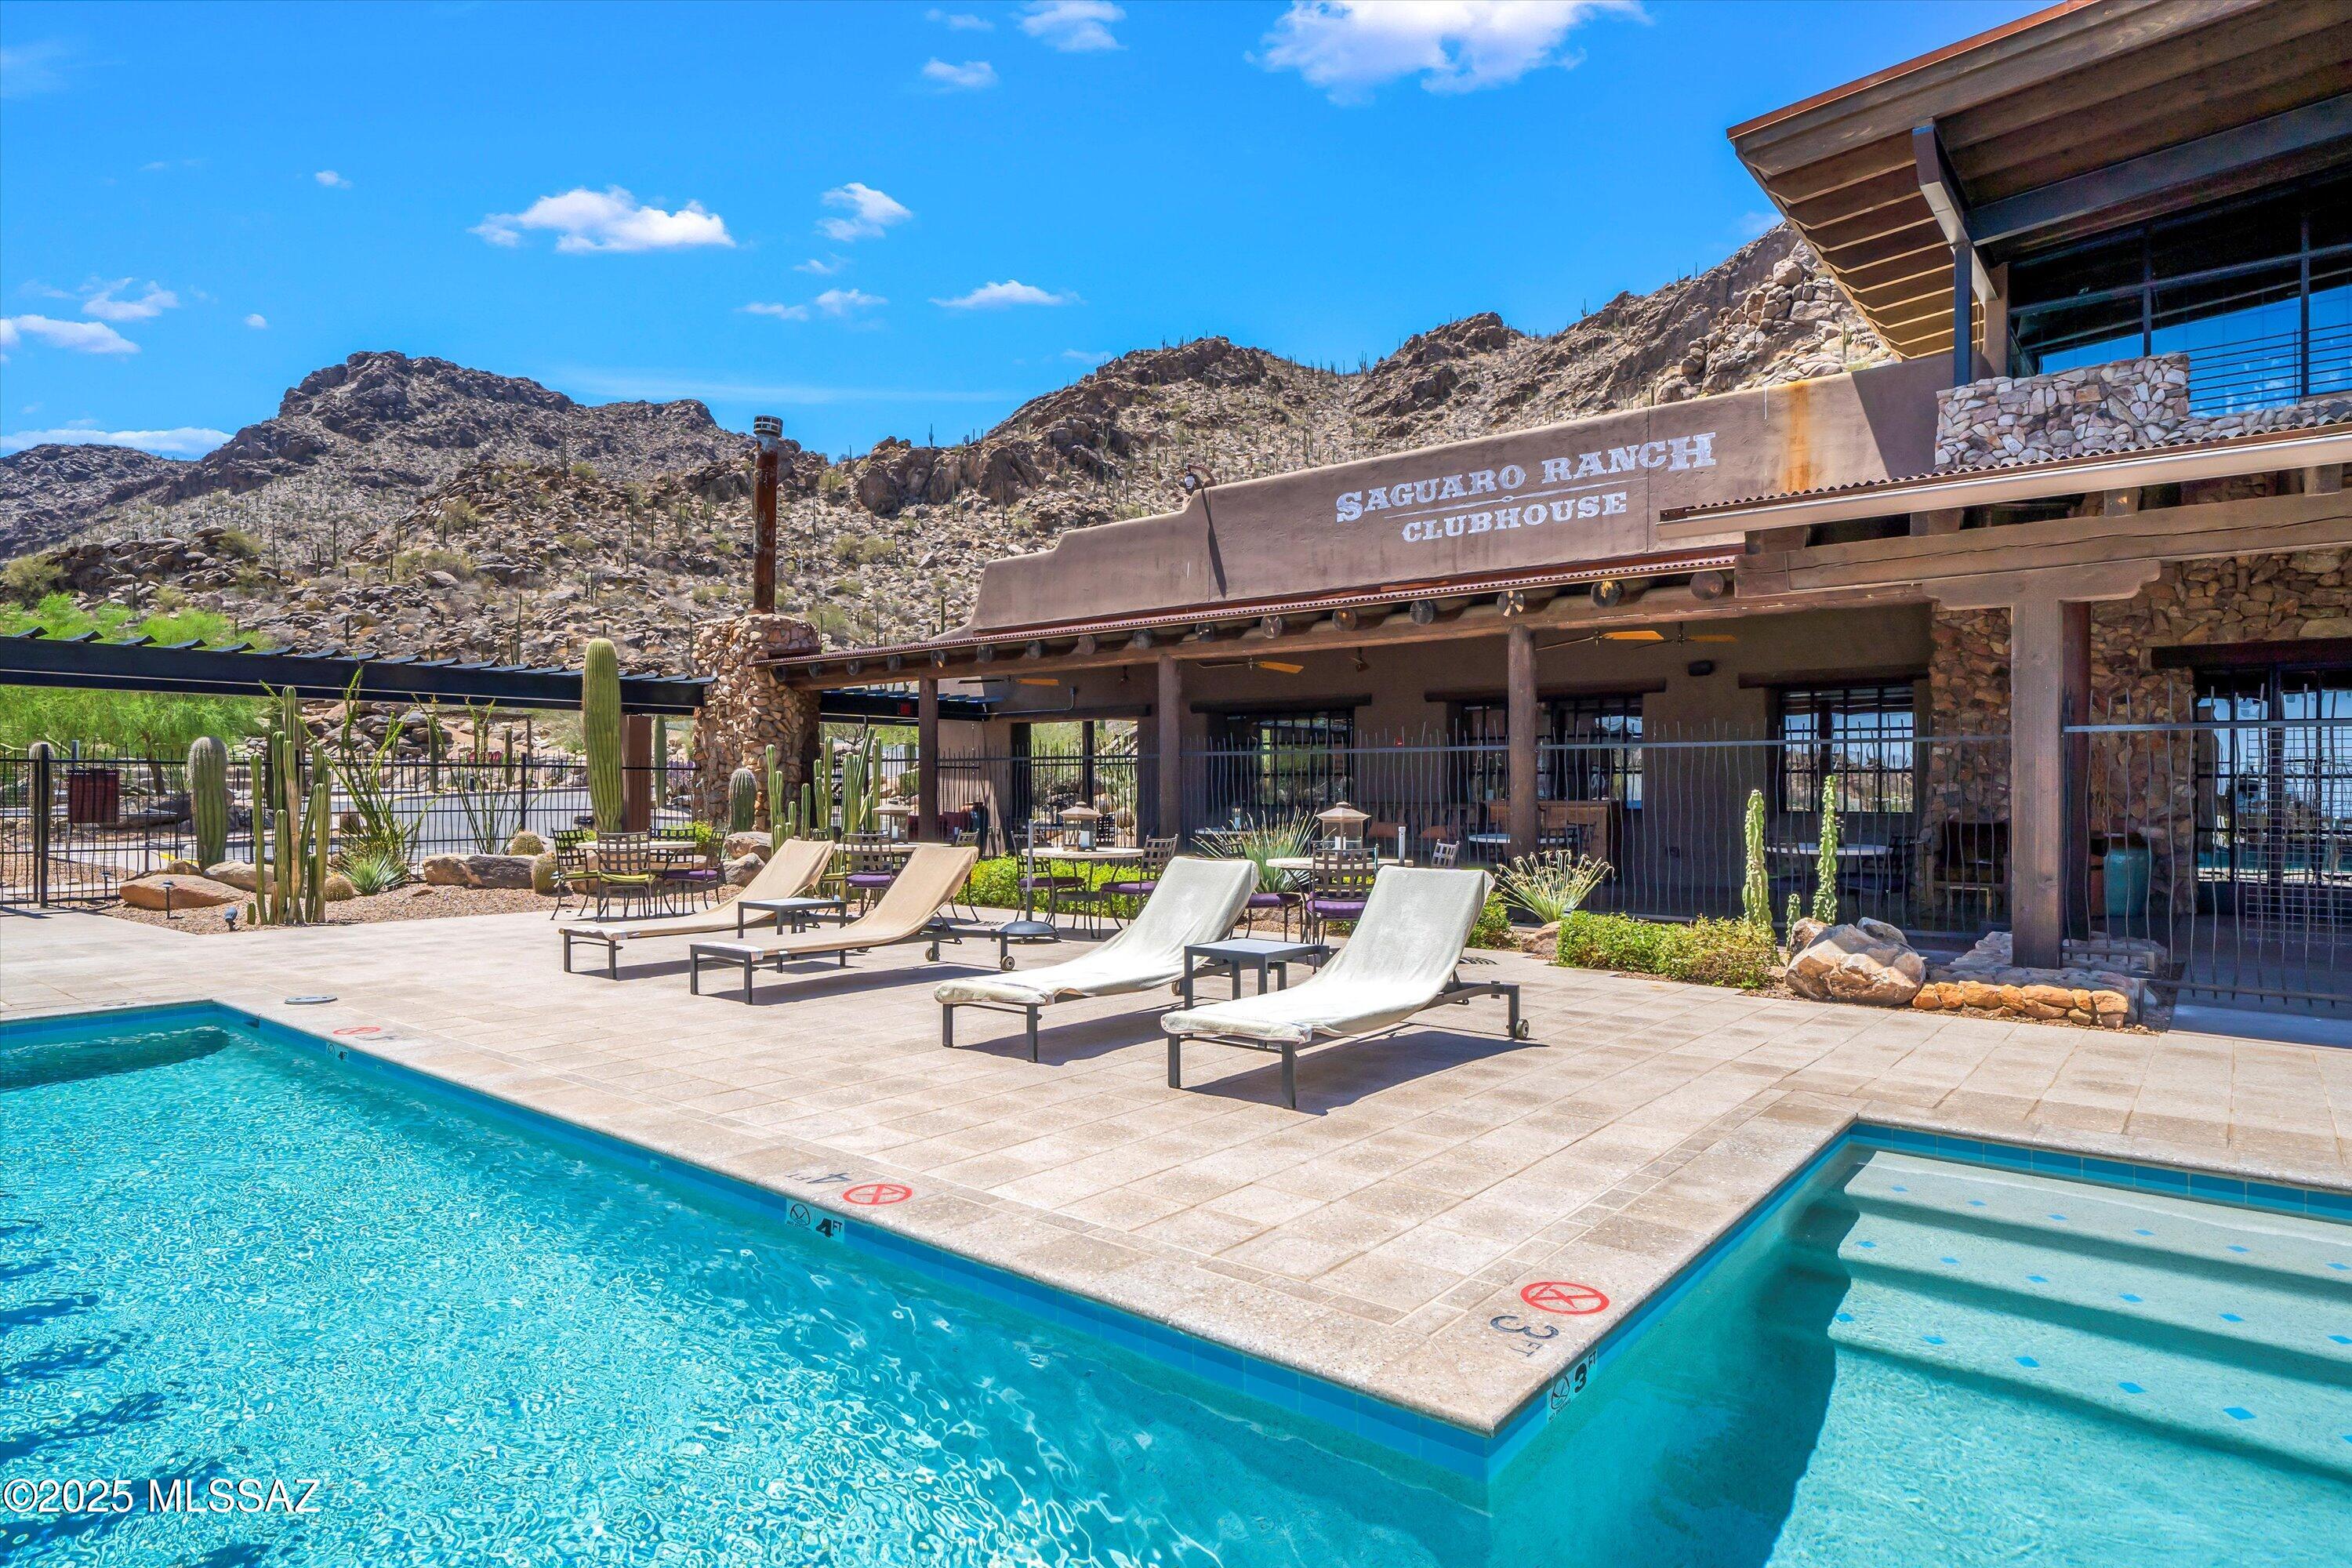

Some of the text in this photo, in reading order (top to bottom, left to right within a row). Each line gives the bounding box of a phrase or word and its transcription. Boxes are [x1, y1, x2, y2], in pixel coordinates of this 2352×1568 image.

[1336, 432, 1716, 523] SAGUARO RANCH
[1401, 491, 1628, 543] CLUBHOUSE
[815, 1218, 833, 1238] 4
[833, 1220, 843, 1232] FT
[1490, 1315, 1559, 1339] 3
[1574, 1350, 1596, 1393] 3 FT
